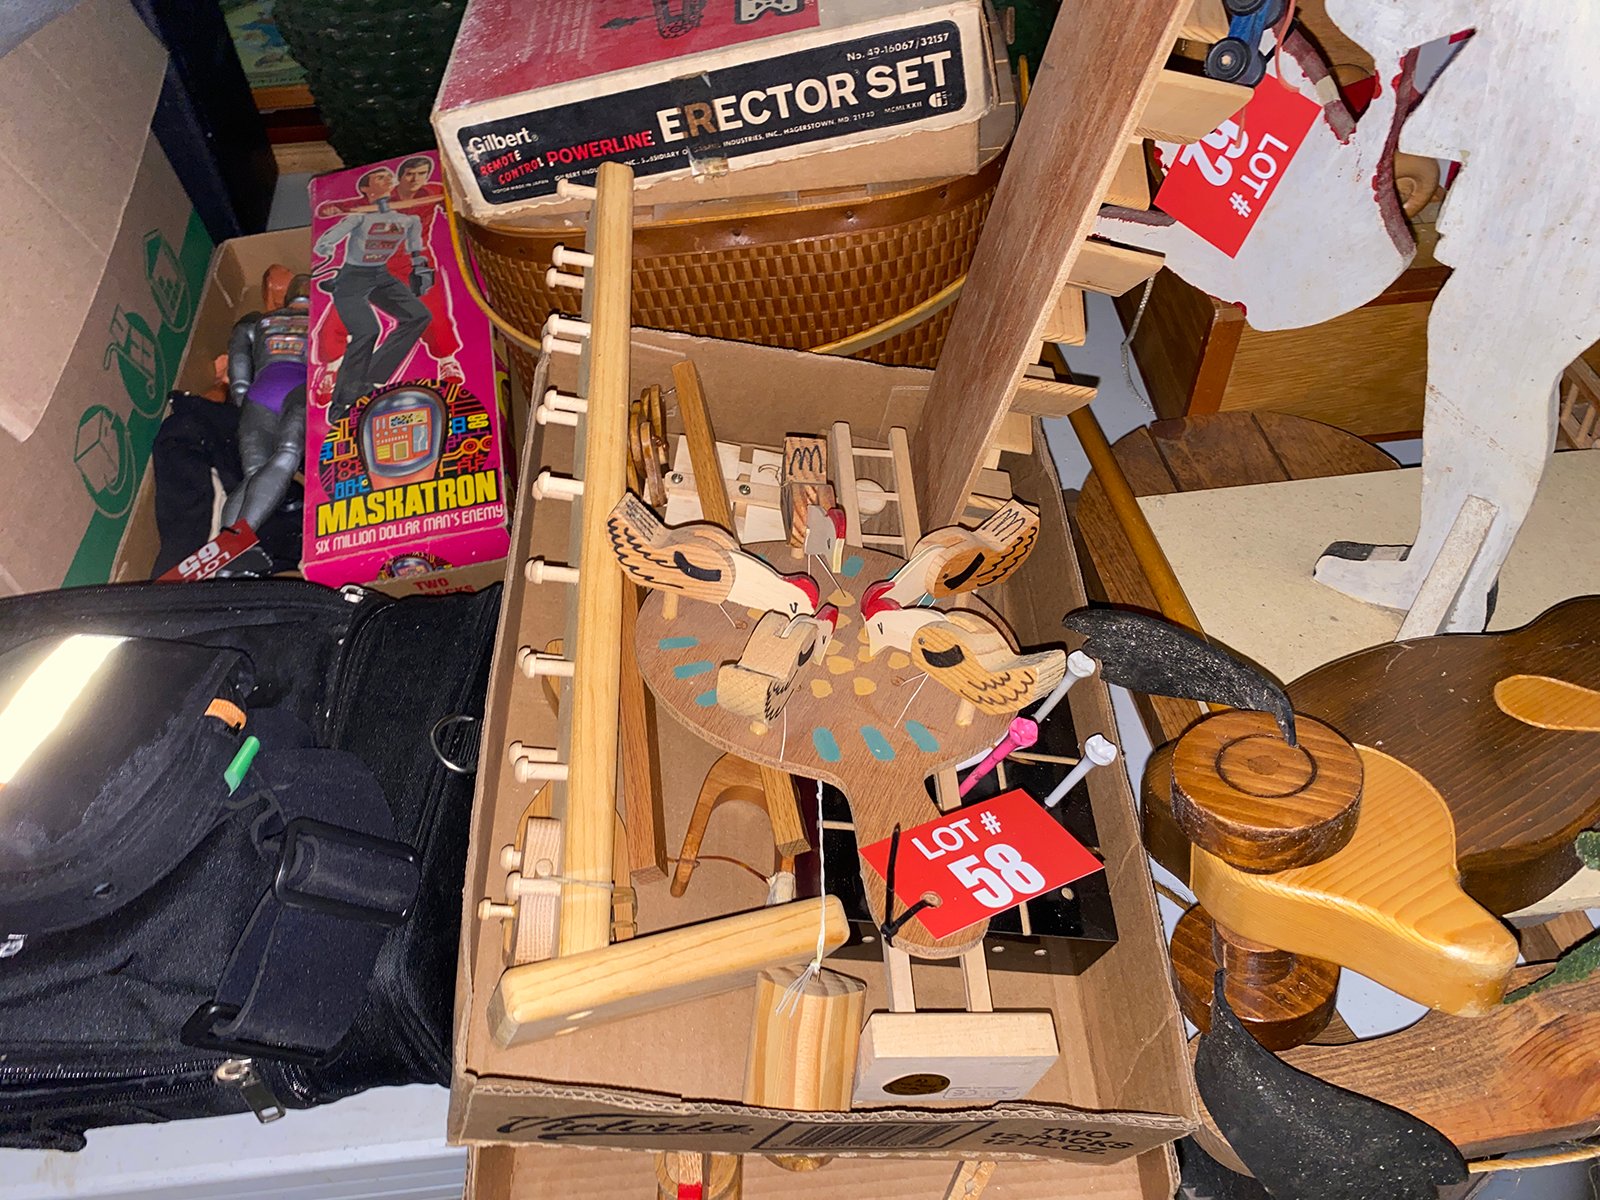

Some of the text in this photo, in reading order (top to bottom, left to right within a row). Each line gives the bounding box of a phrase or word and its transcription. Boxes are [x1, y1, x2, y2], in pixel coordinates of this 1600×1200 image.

[656, 50, 952, 143] ERECTOR SET
[479, 150, 521, 176] REMOTE
[497, 157, 545, 185] CONTROL
[545, 129, 656, 167] POWERLINE
[1178, 118, 1249, 187] 62
[1246, 133, 1289, 200] LOT
[317, 470, 498, 538] MASKATRON
[315, 503, 505, 556] SIX MILLION DOLLAR MAN'S ENEMY
[178, 541, 221, 578] 65
[413, 577, 449, 590] TWO
[911, 811, 1002, 861] LOT #
[946, 843, 1046, 909] 58
[1042, 1127, 1113, 1139] TWO
